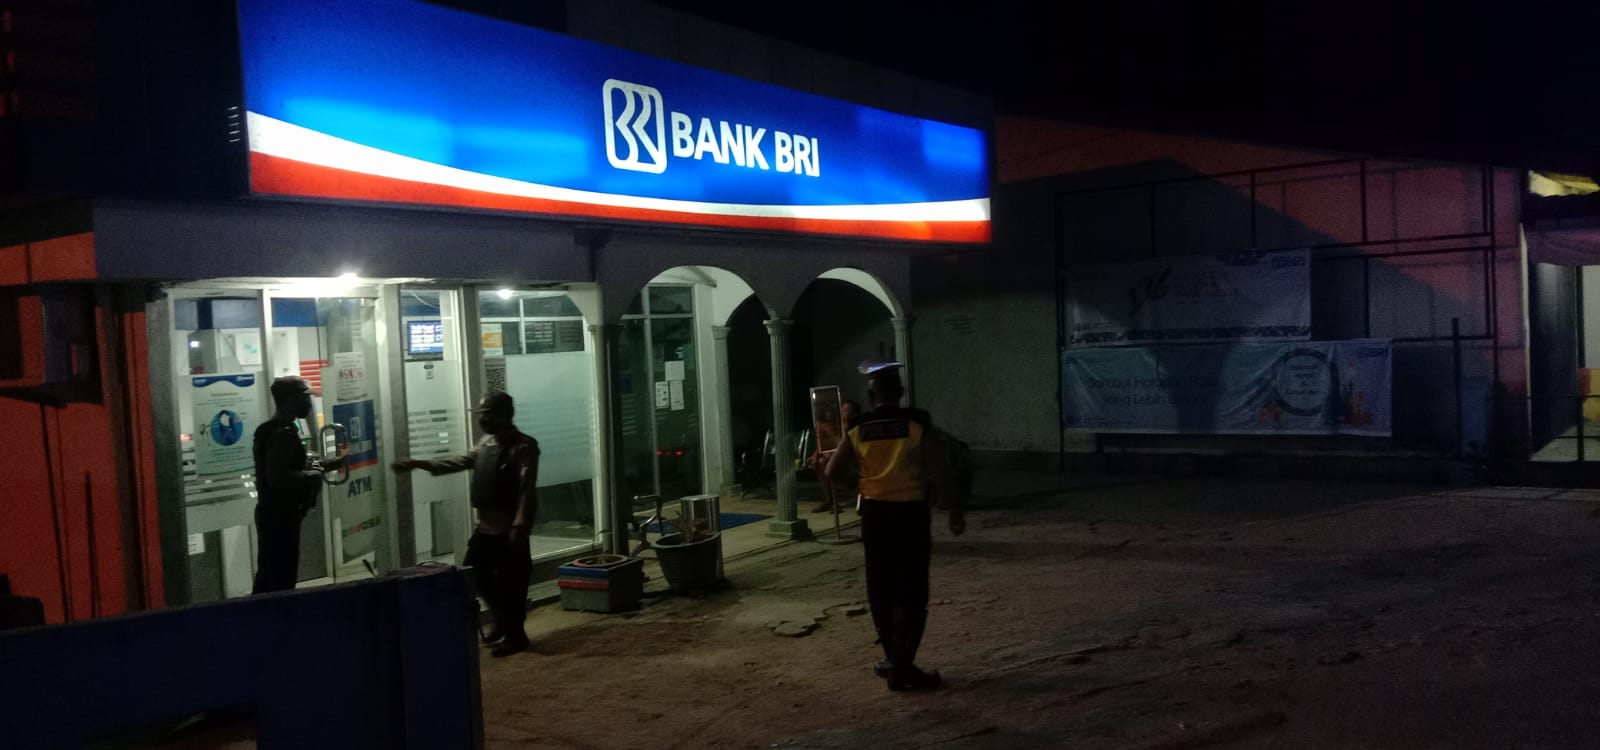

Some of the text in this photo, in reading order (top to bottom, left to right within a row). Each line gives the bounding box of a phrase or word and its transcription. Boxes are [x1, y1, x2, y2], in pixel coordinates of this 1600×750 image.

[671, 111, 820, 177] BANK BRI
[347, 475, 372, 498] ATM
